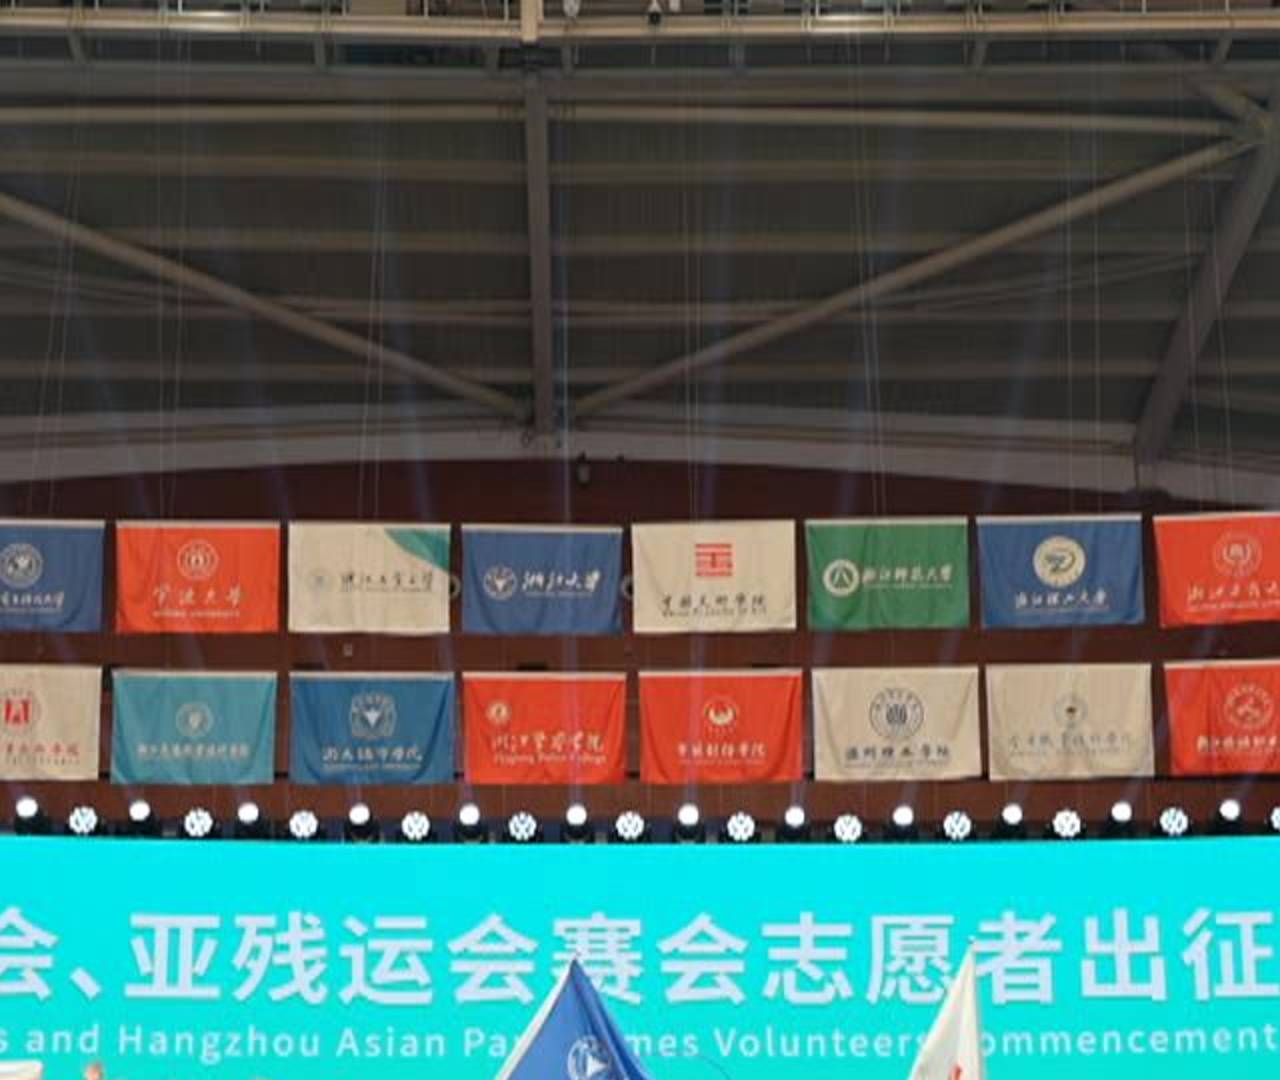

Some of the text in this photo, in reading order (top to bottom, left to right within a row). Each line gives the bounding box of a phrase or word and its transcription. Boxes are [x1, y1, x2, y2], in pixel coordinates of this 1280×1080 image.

[26, 1025, 104, 1053] and
[119, 1026, 318, 1064] Hangzhou
[337, 1027, 444, 1056] Asian
[978, 1024, 1276, 1056] ommencement
